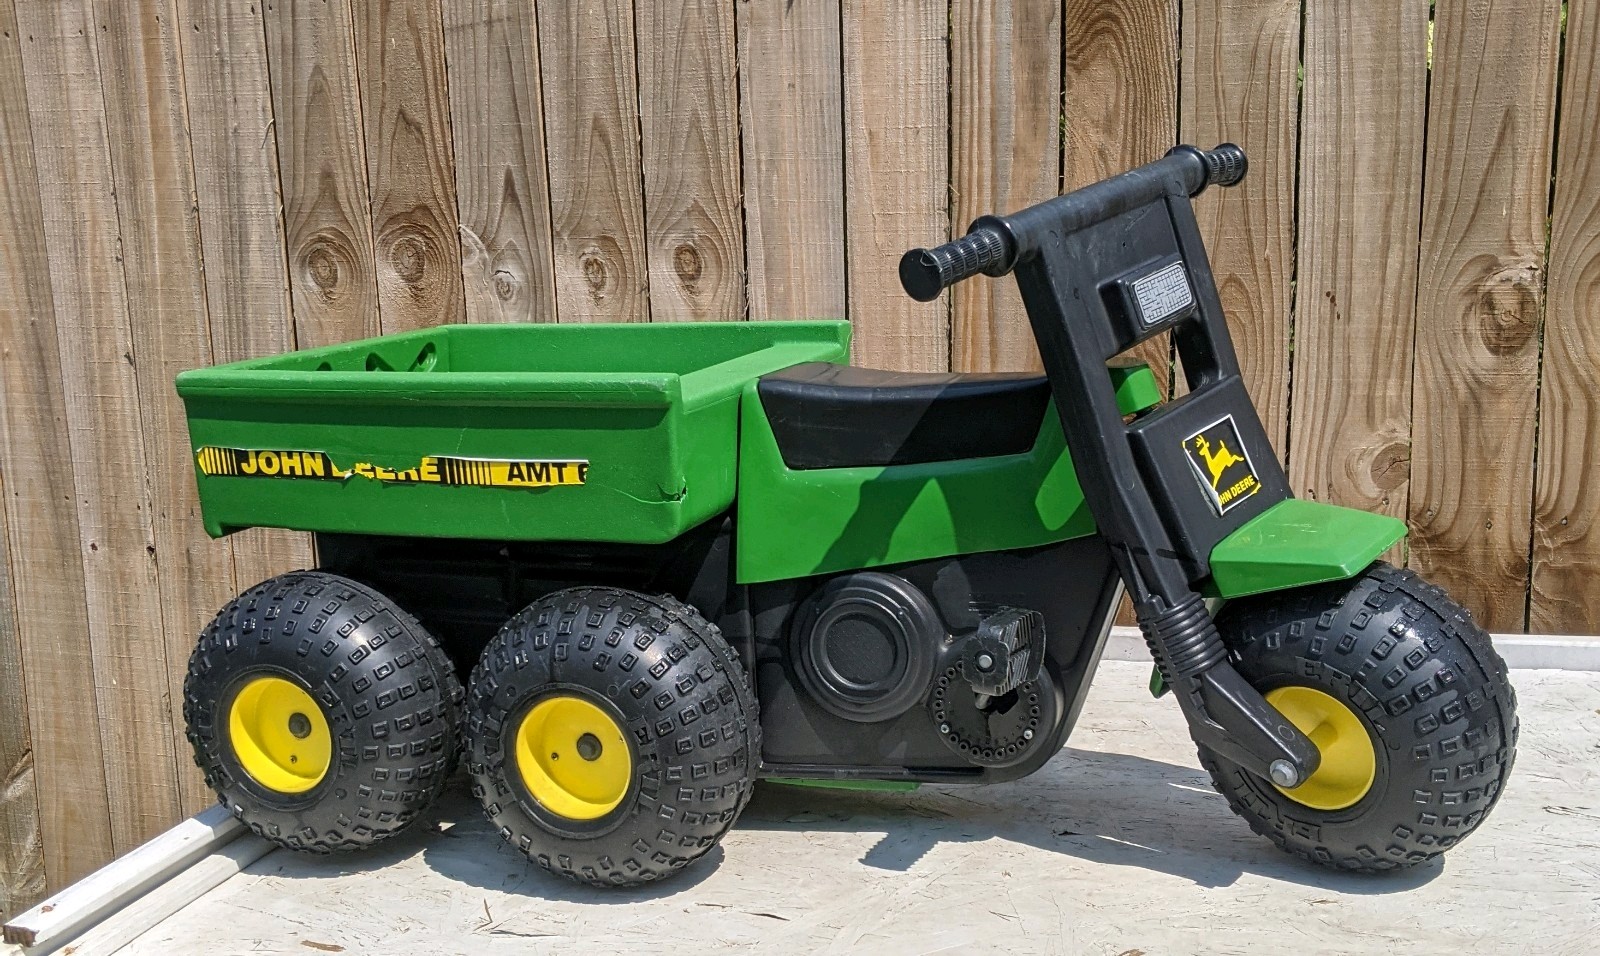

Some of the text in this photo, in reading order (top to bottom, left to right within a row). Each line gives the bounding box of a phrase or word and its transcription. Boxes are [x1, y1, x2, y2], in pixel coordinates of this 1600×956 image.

[241, 450, 325, 477] JOHN
[331, 456, 441, 482] EEE
[507, 461, 568, 483] AMT
[1229, 474, 1256, 498] DEERE
